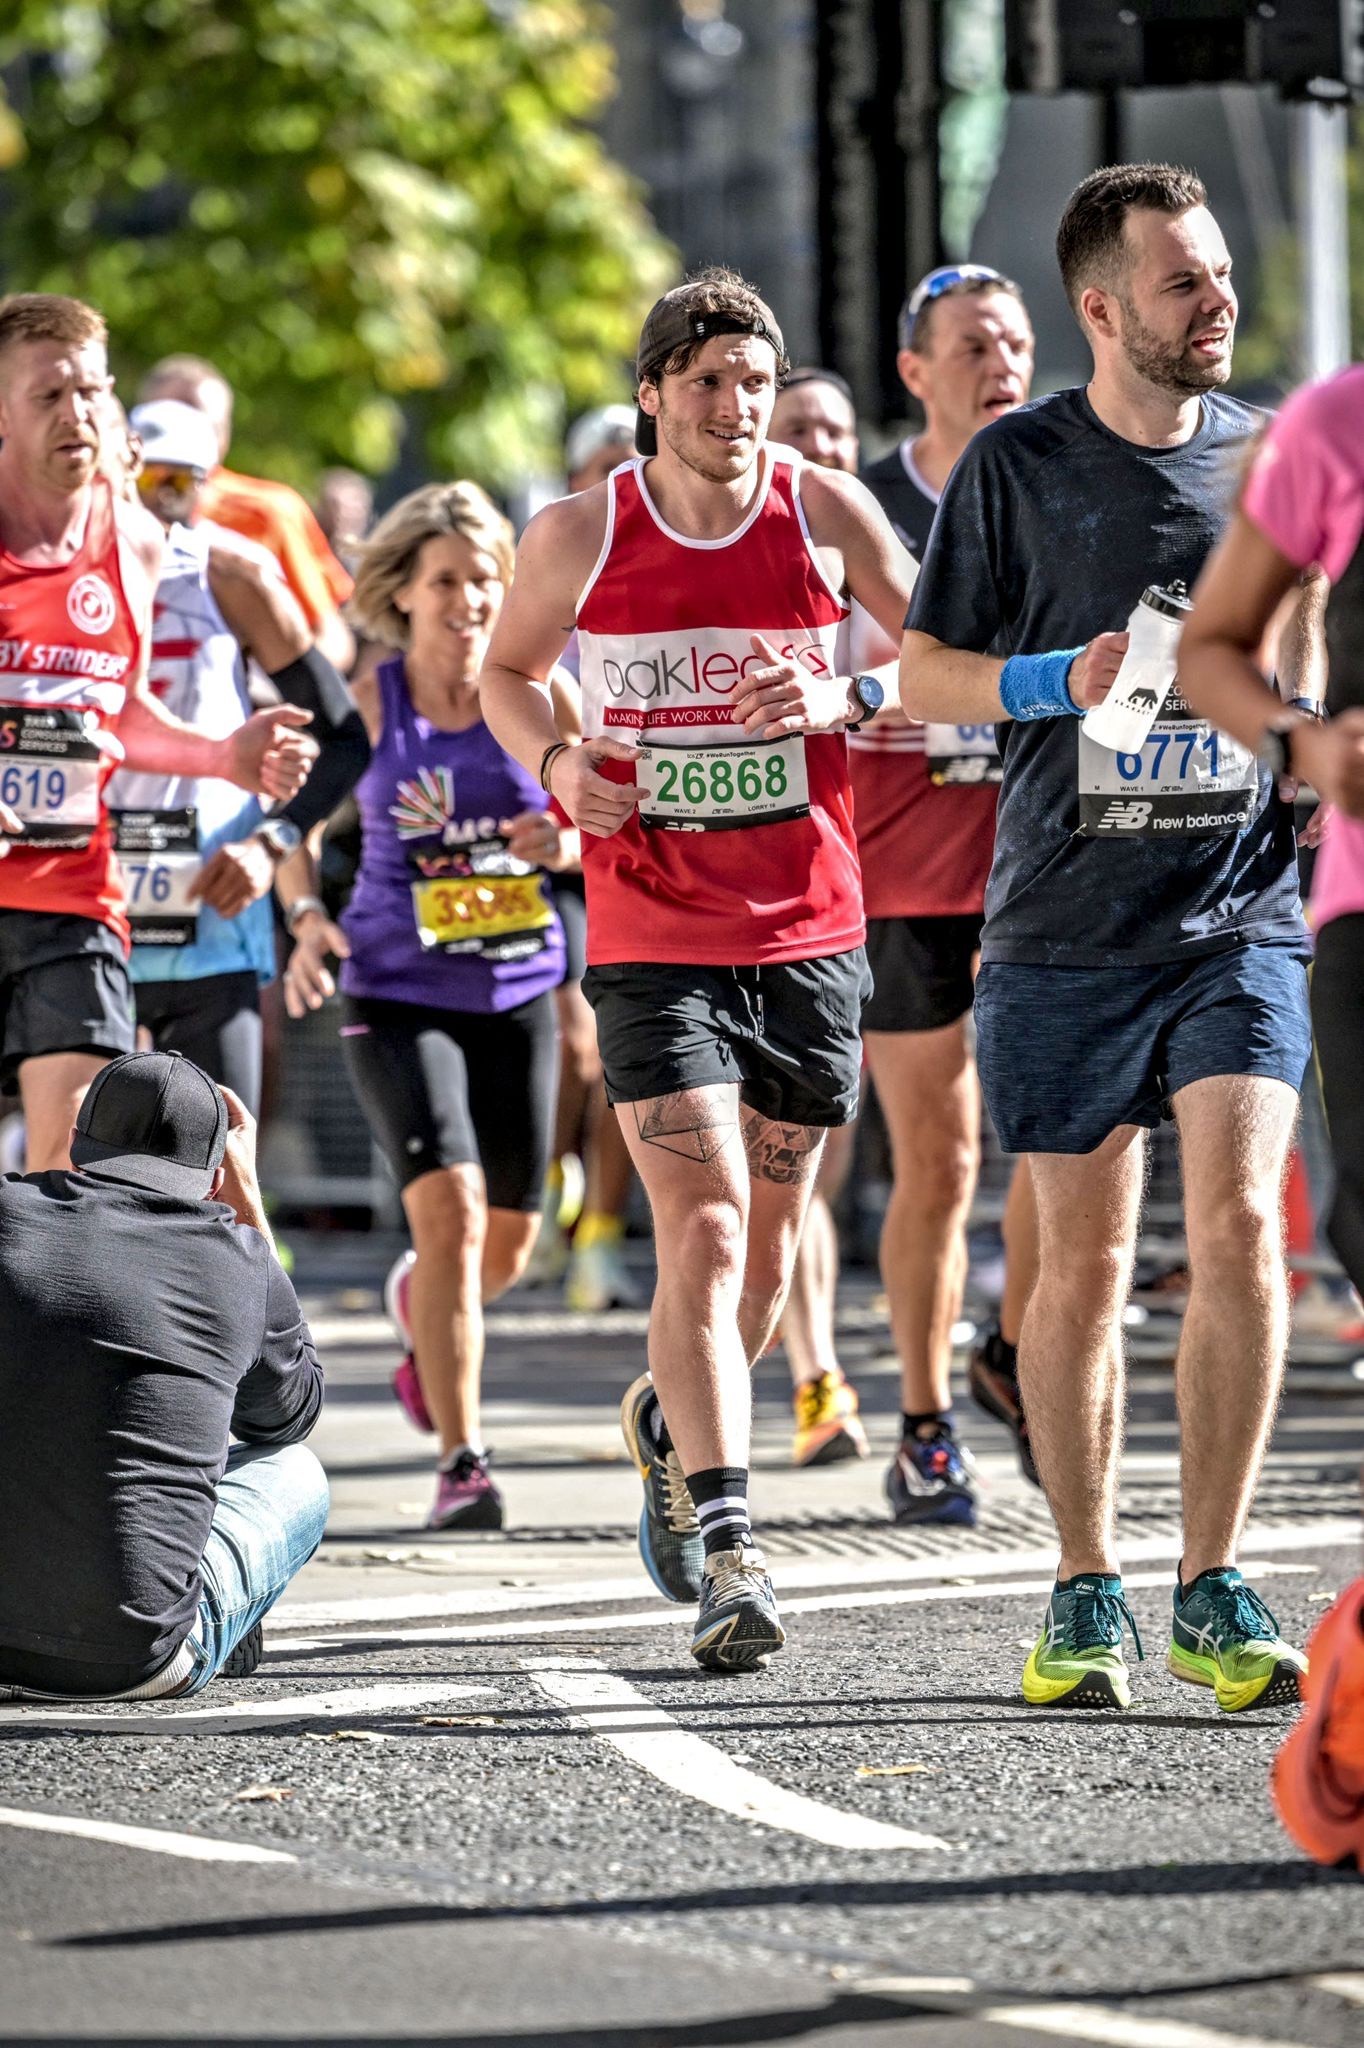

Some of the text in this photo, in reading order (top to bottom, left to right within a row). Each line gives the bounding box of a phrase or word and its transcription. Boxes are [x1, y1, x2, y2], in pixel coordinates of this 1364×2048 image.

[648, 712, 667, 725] LIFE
[671, 710, 711, 724] WORK
[1116, 730, 1219, 780] 6771
[1, 767, 66, 810] 619
[656, 754, 787, 804] 26868
[1153, 811, 1246, 829] new balance
[129, 865, 171, 902] 76
